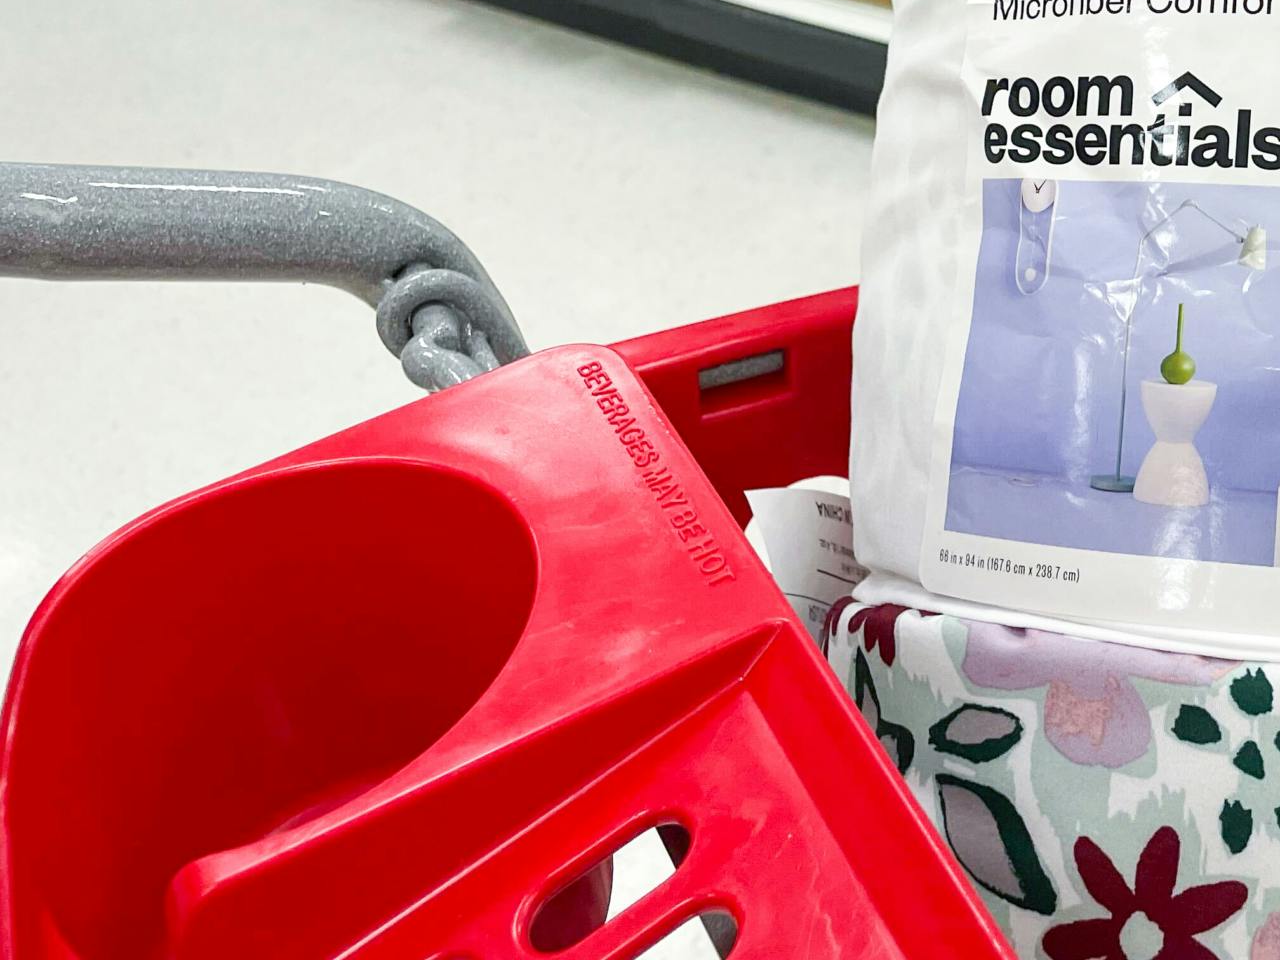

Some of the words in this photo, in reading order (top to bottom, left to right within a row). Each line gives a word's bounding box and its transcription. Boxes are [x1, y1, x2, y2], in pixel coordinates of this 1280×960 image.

[981, 74, 1134, 118] room
[576, 360, 660, 468] BEVERAGES
[642, 466, 689, 510] MAY
[669, 506, 704, 544] BE
[687, 530, 737, 588] HOT
[815, 501, 843, 522] CHINA
[965, 553, 975, 567] 94
[977, 557, 985, 569] in
[1013, 564, 1026, 576] cm
[1028, 566, 1033, 577] x
[1062, 568, 1081, 584] cm)
